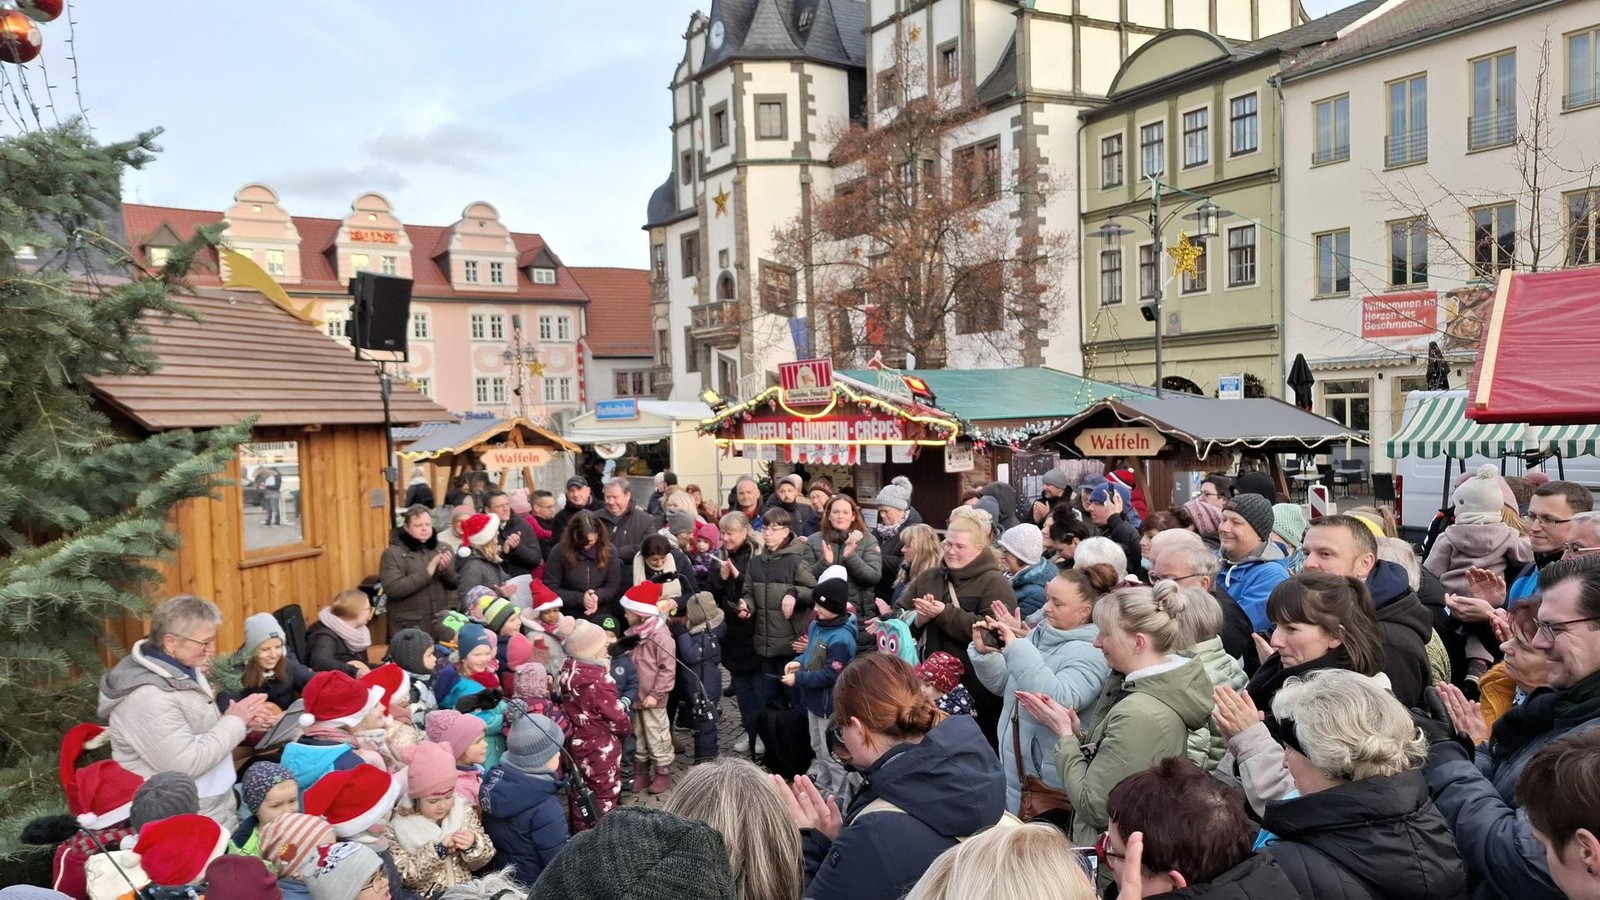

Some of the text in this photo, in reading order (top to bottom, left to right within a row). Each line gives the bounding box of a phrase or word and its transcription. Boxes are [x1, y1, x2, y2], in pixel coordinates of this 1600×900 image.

[1365, 300, 1421, 310] Willkommen
[1365, 310, 1416, 321] Herzen des
[743, 417, 903, 440] WAFFELN GLÜHWEIN CRÊPES
[1090, 433, 1150, 450] Waffeln
[494, 452, 540, 463] Waffeln
